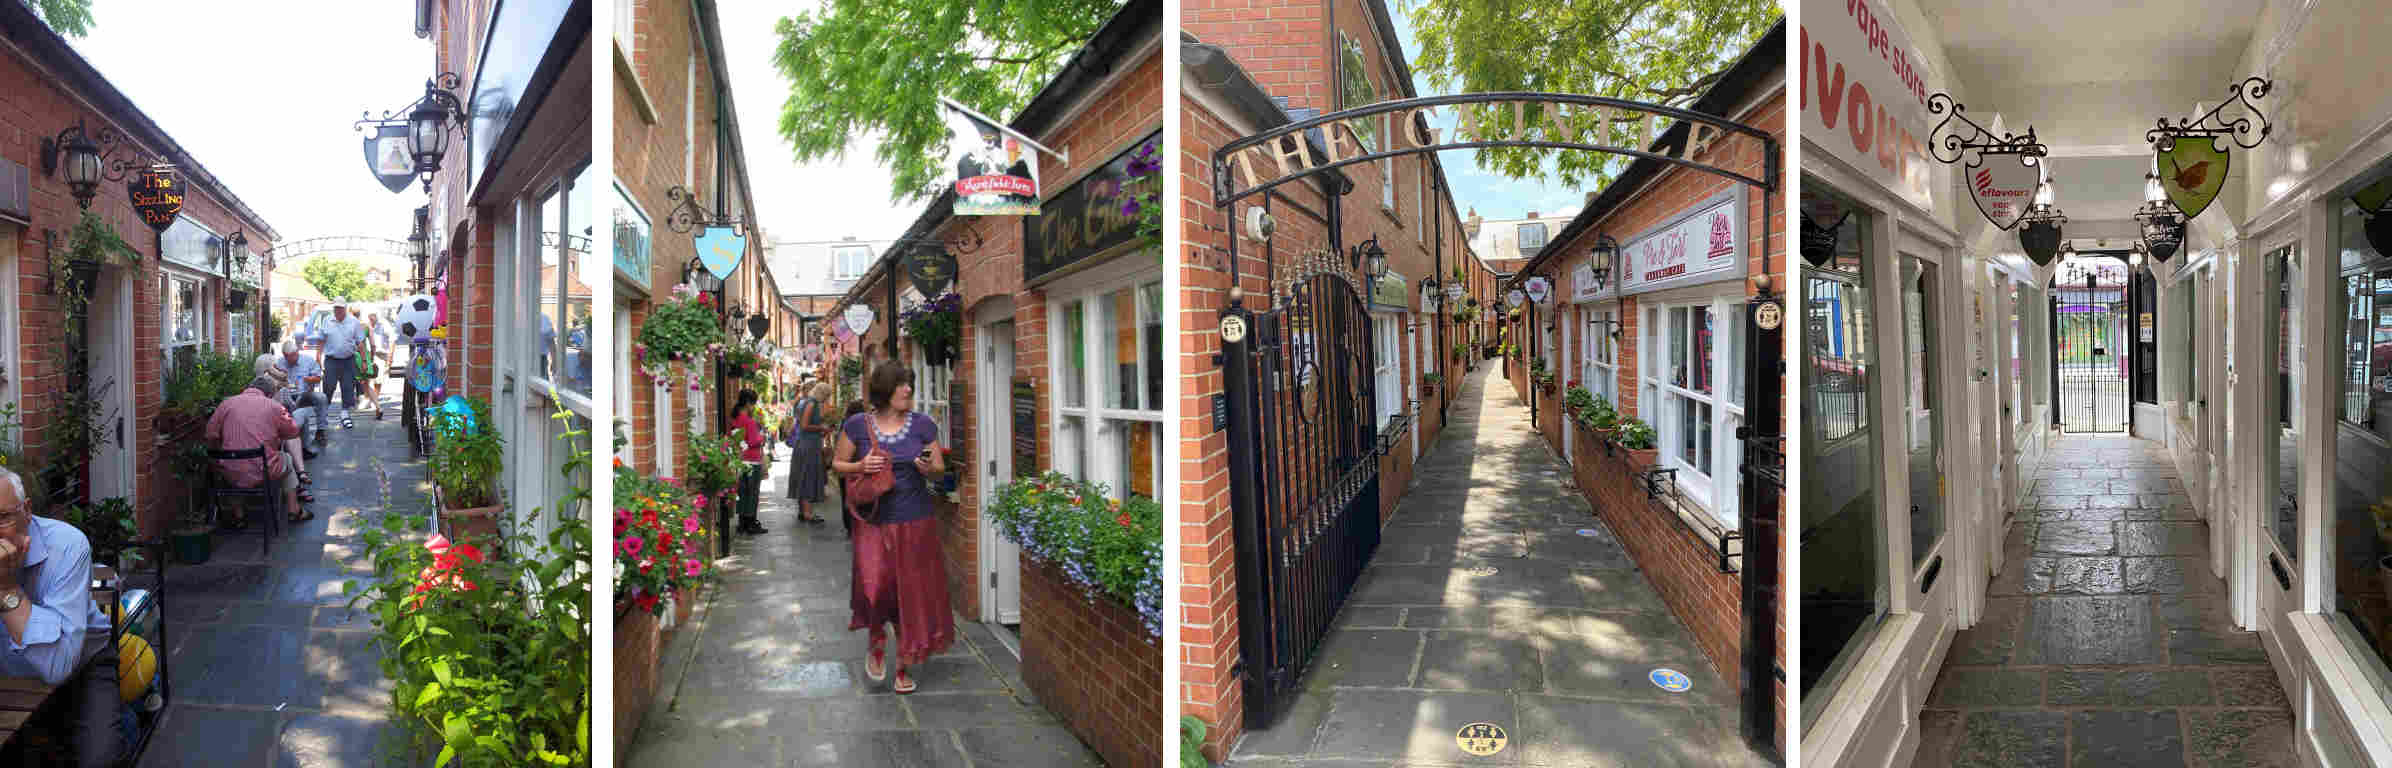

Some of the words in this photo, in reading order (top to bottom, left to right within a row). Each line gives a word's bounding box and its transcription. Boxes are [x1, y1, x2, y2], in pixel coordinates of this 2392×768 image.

[1892, 46, 1926, 104] store
[144, 174, 171, 188] The
[1224, 118, 1361, 188] THE
[1040, 205, 1078, 264] The
